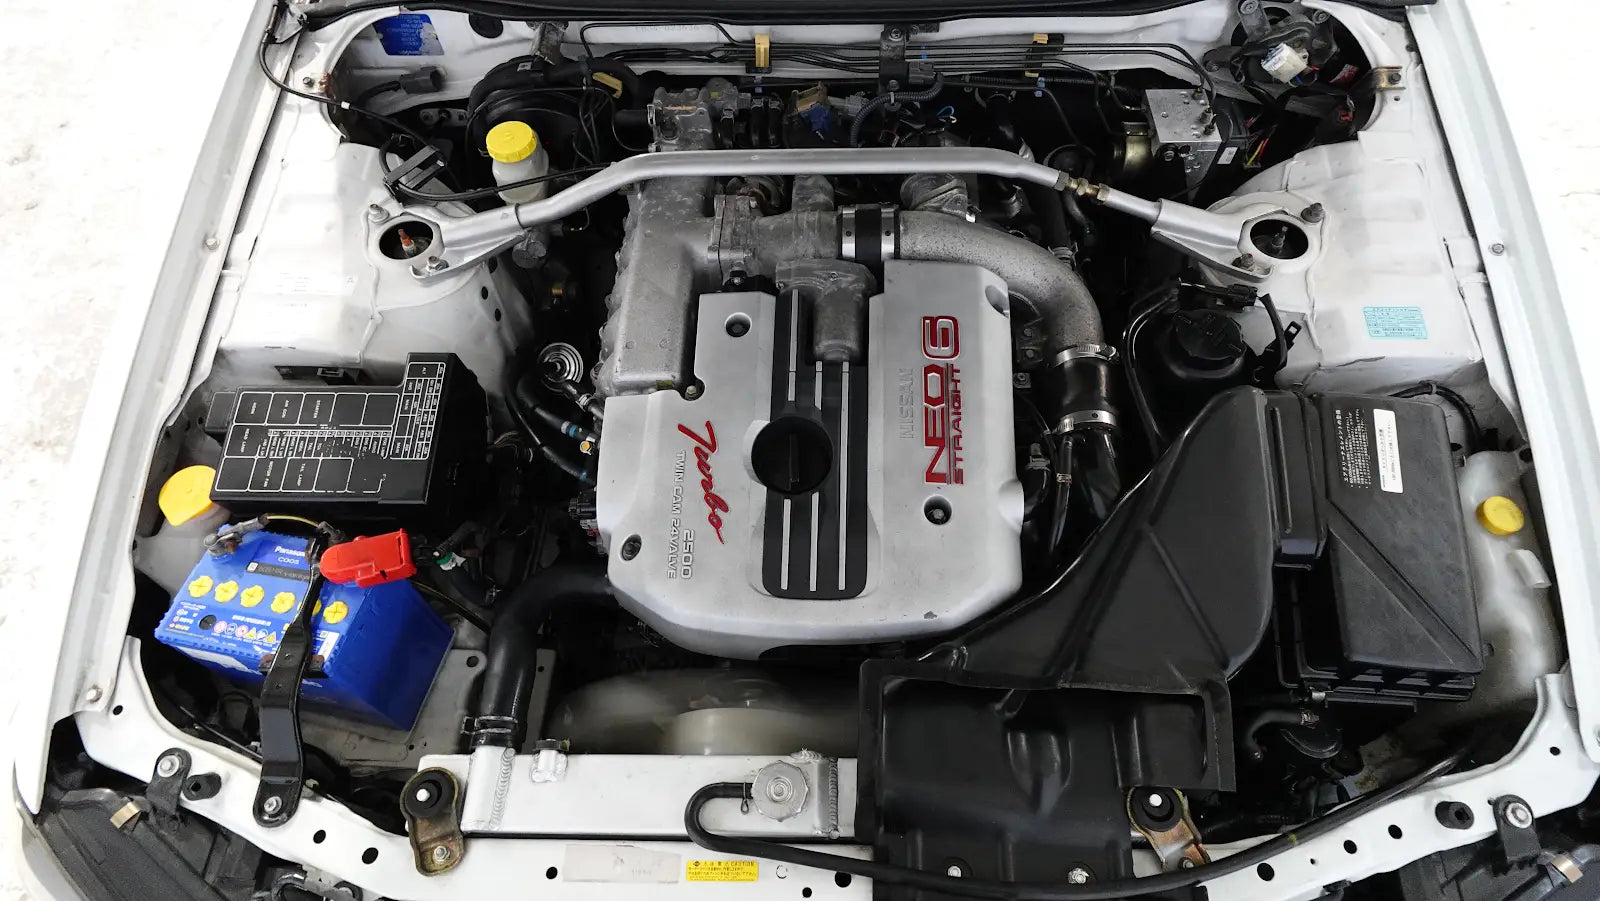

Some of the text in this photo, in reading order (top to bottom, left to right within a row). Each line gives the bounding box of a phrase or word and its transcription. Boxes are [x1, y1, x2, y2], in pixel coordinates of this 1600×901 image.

[313, 400, 321, 418] STARTER
[899, 368, 913, 439] NISSAN
[951, 363, 964, 485] STRAIGHT
[667, 450, 686, 579] TWIN CAM 24VALVE
[678, 420, 730, 544] Turbo
[275, 546, 305, 557] Panason
[681, 529, 694, 579] 2500
